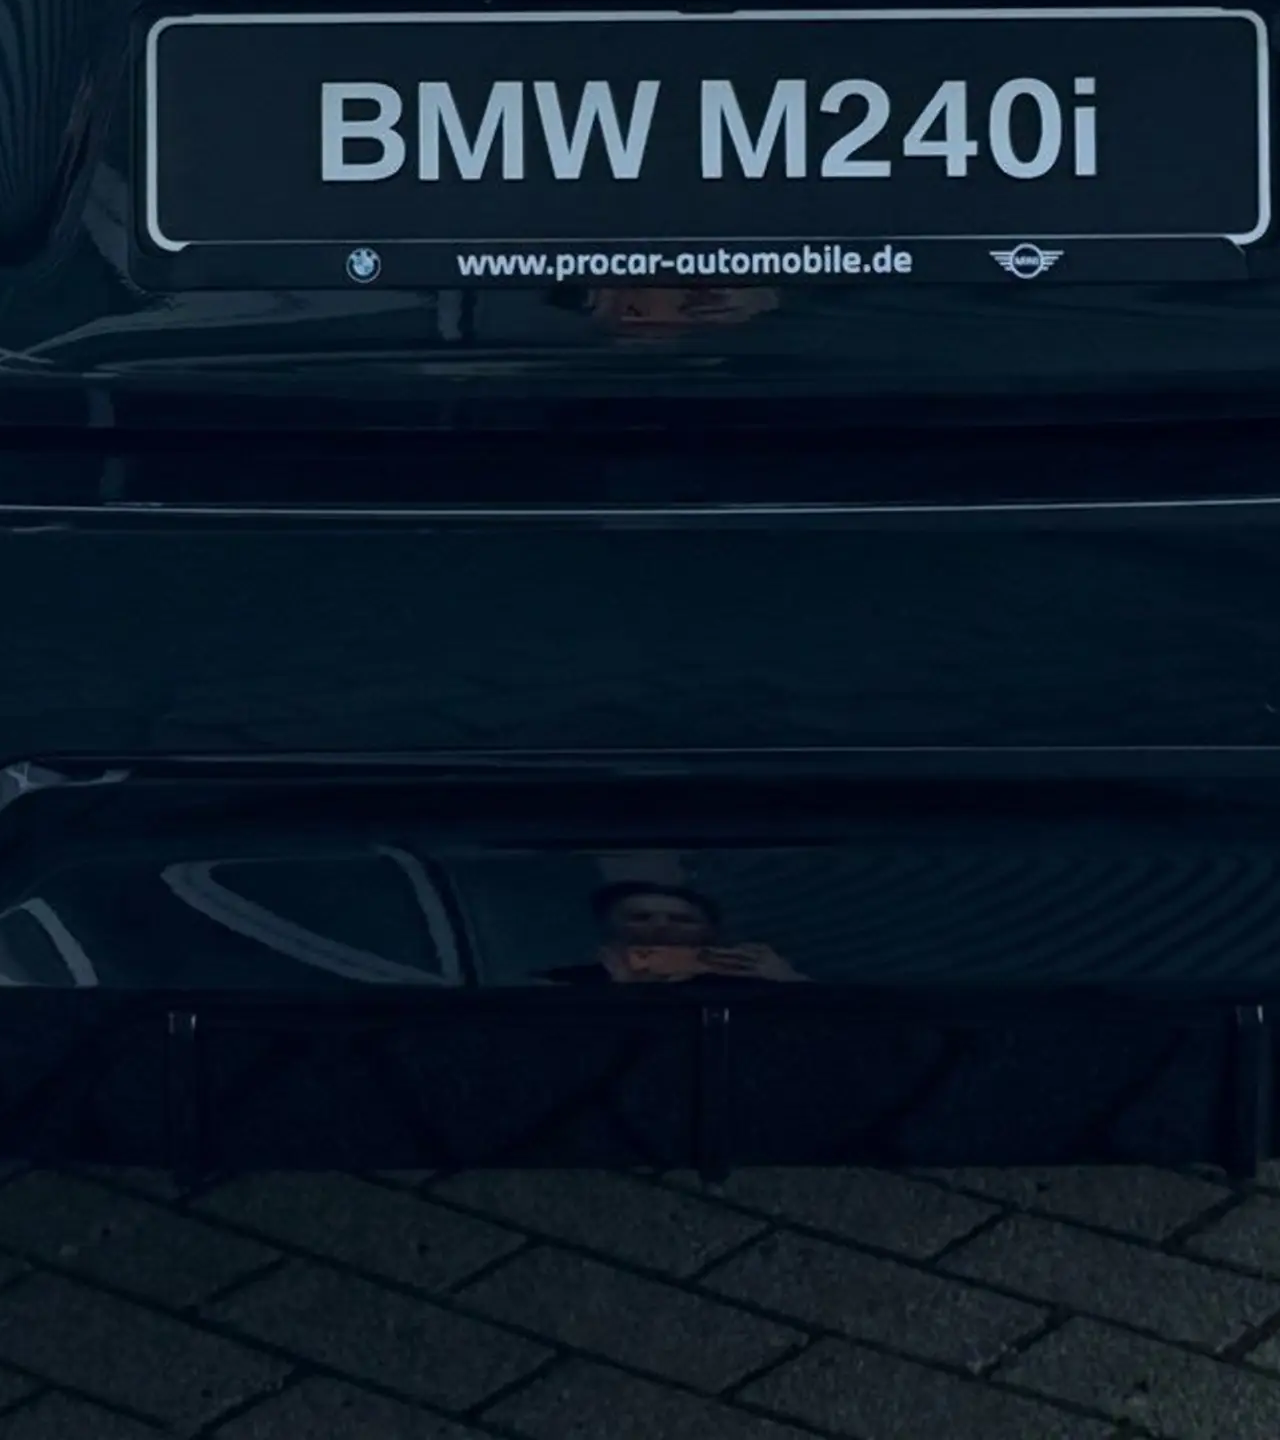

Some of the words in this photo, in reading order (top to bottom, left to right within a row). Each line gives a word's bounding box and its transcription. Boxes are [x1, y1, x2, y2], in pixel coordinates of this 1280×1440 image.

[321, 80, 661, 181] BMW
[701, 77, 1097, 179] M240i
[457, 245, 913, 281] www.procar-automobile.de
